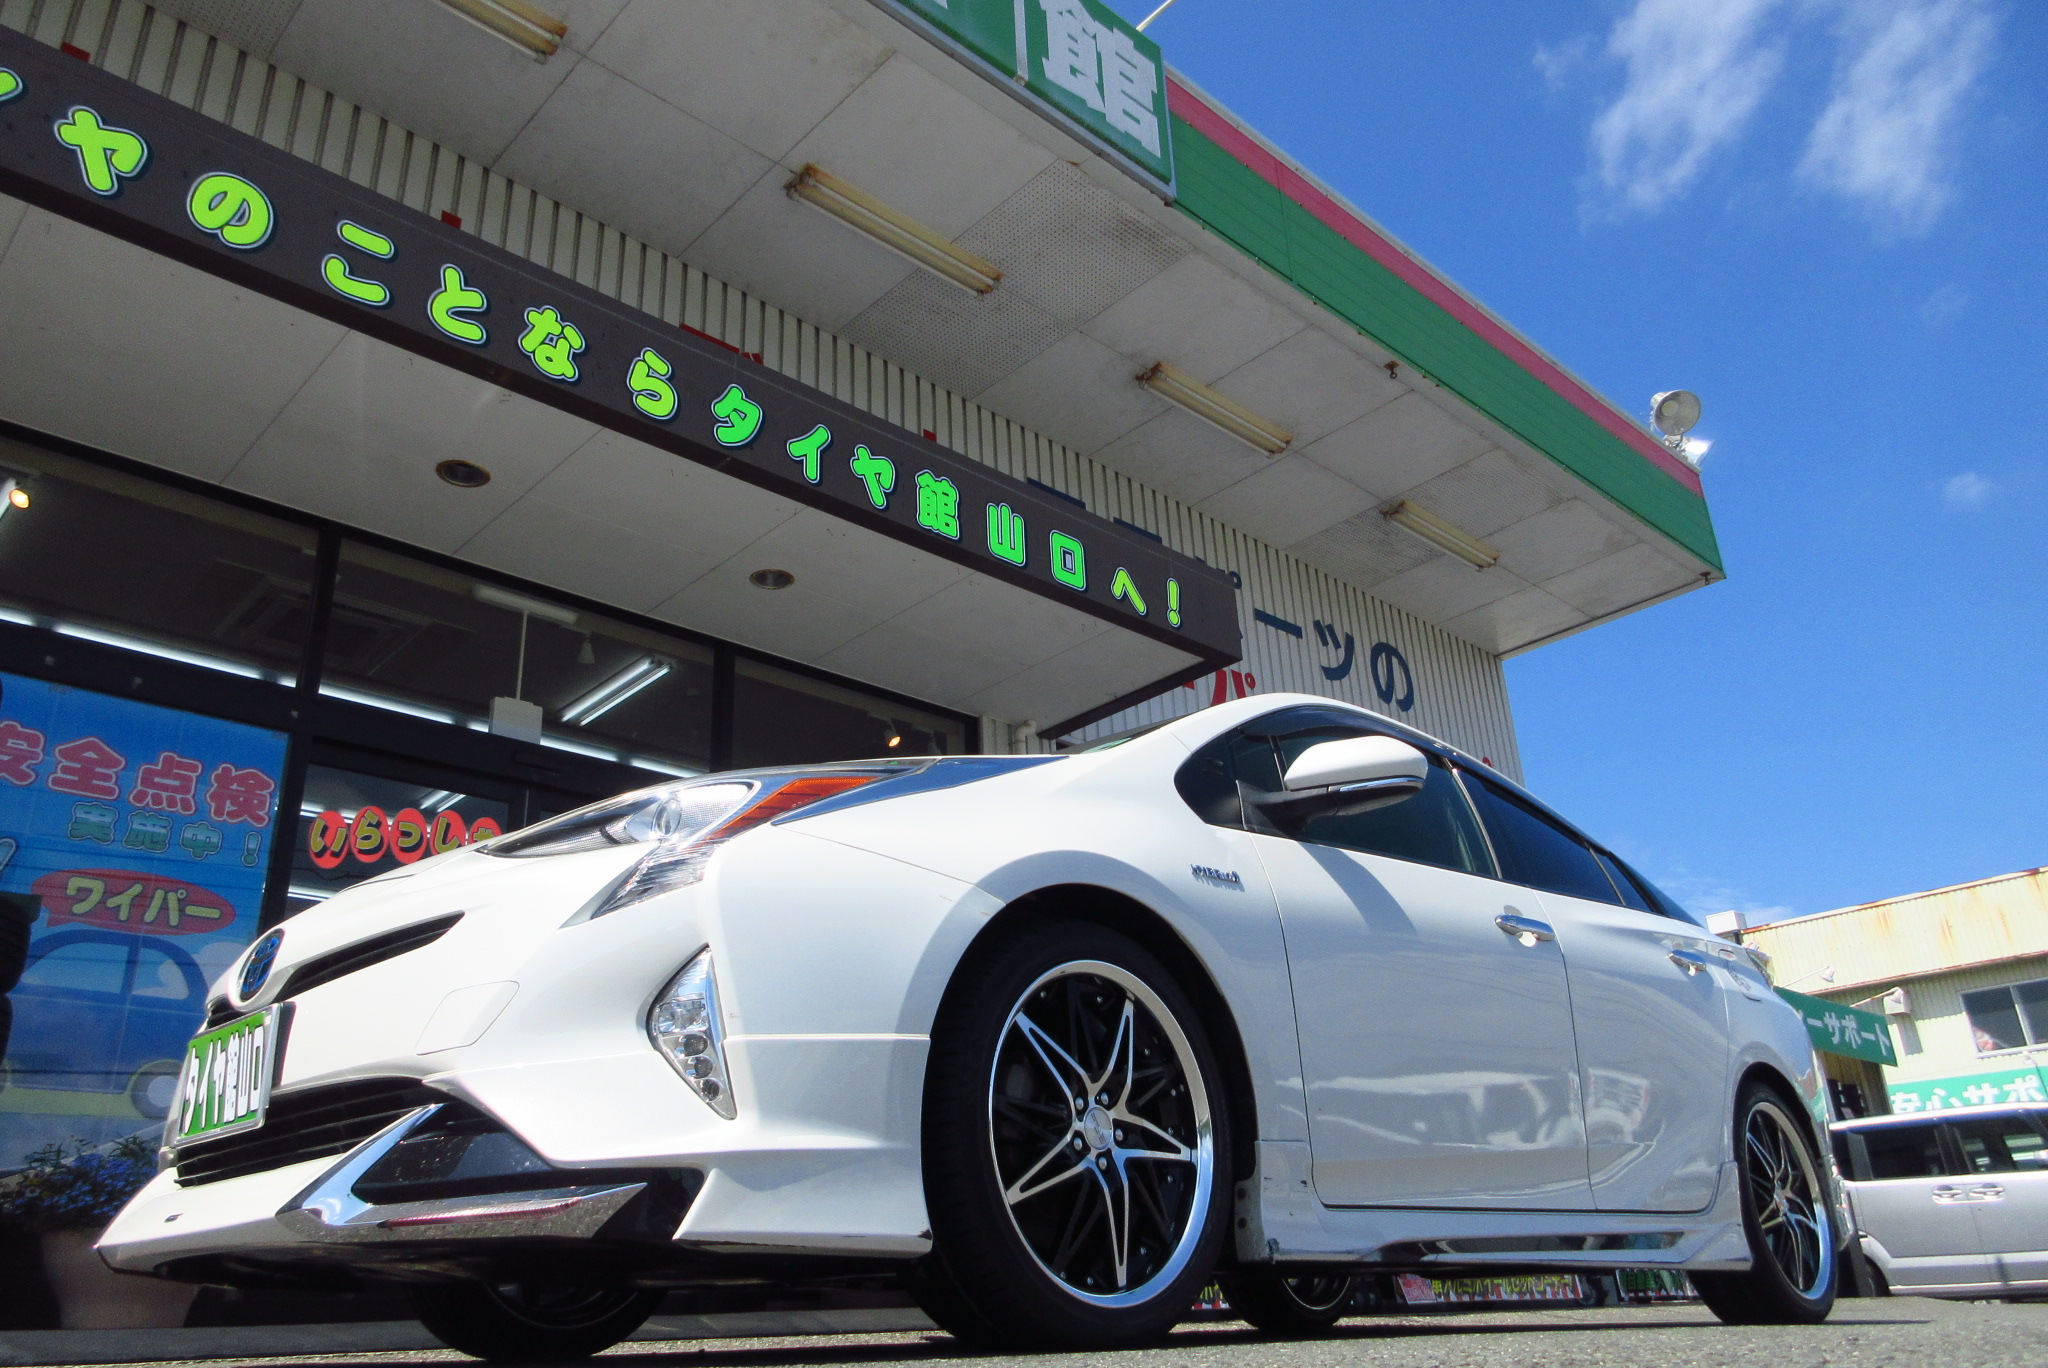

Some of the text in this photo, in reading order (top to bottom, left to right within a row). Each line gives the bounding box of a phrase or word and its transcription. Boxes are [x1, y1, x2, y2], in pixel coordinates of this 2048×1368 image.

[0, 67, 1183, 628] ヤのことならタイヤ館山口へ!
[1230, 570, 1415, 712] ーツの
[0, 721, 276, 827] 安全点検
[66, 876, 222, 927] ワイパー
[184, 1023, 265, 1134] タイヤ館山口
[1798, 1009, 1892, 1057] ーサポート
[1890, 1074, 2048, 1114] 安心サポ
